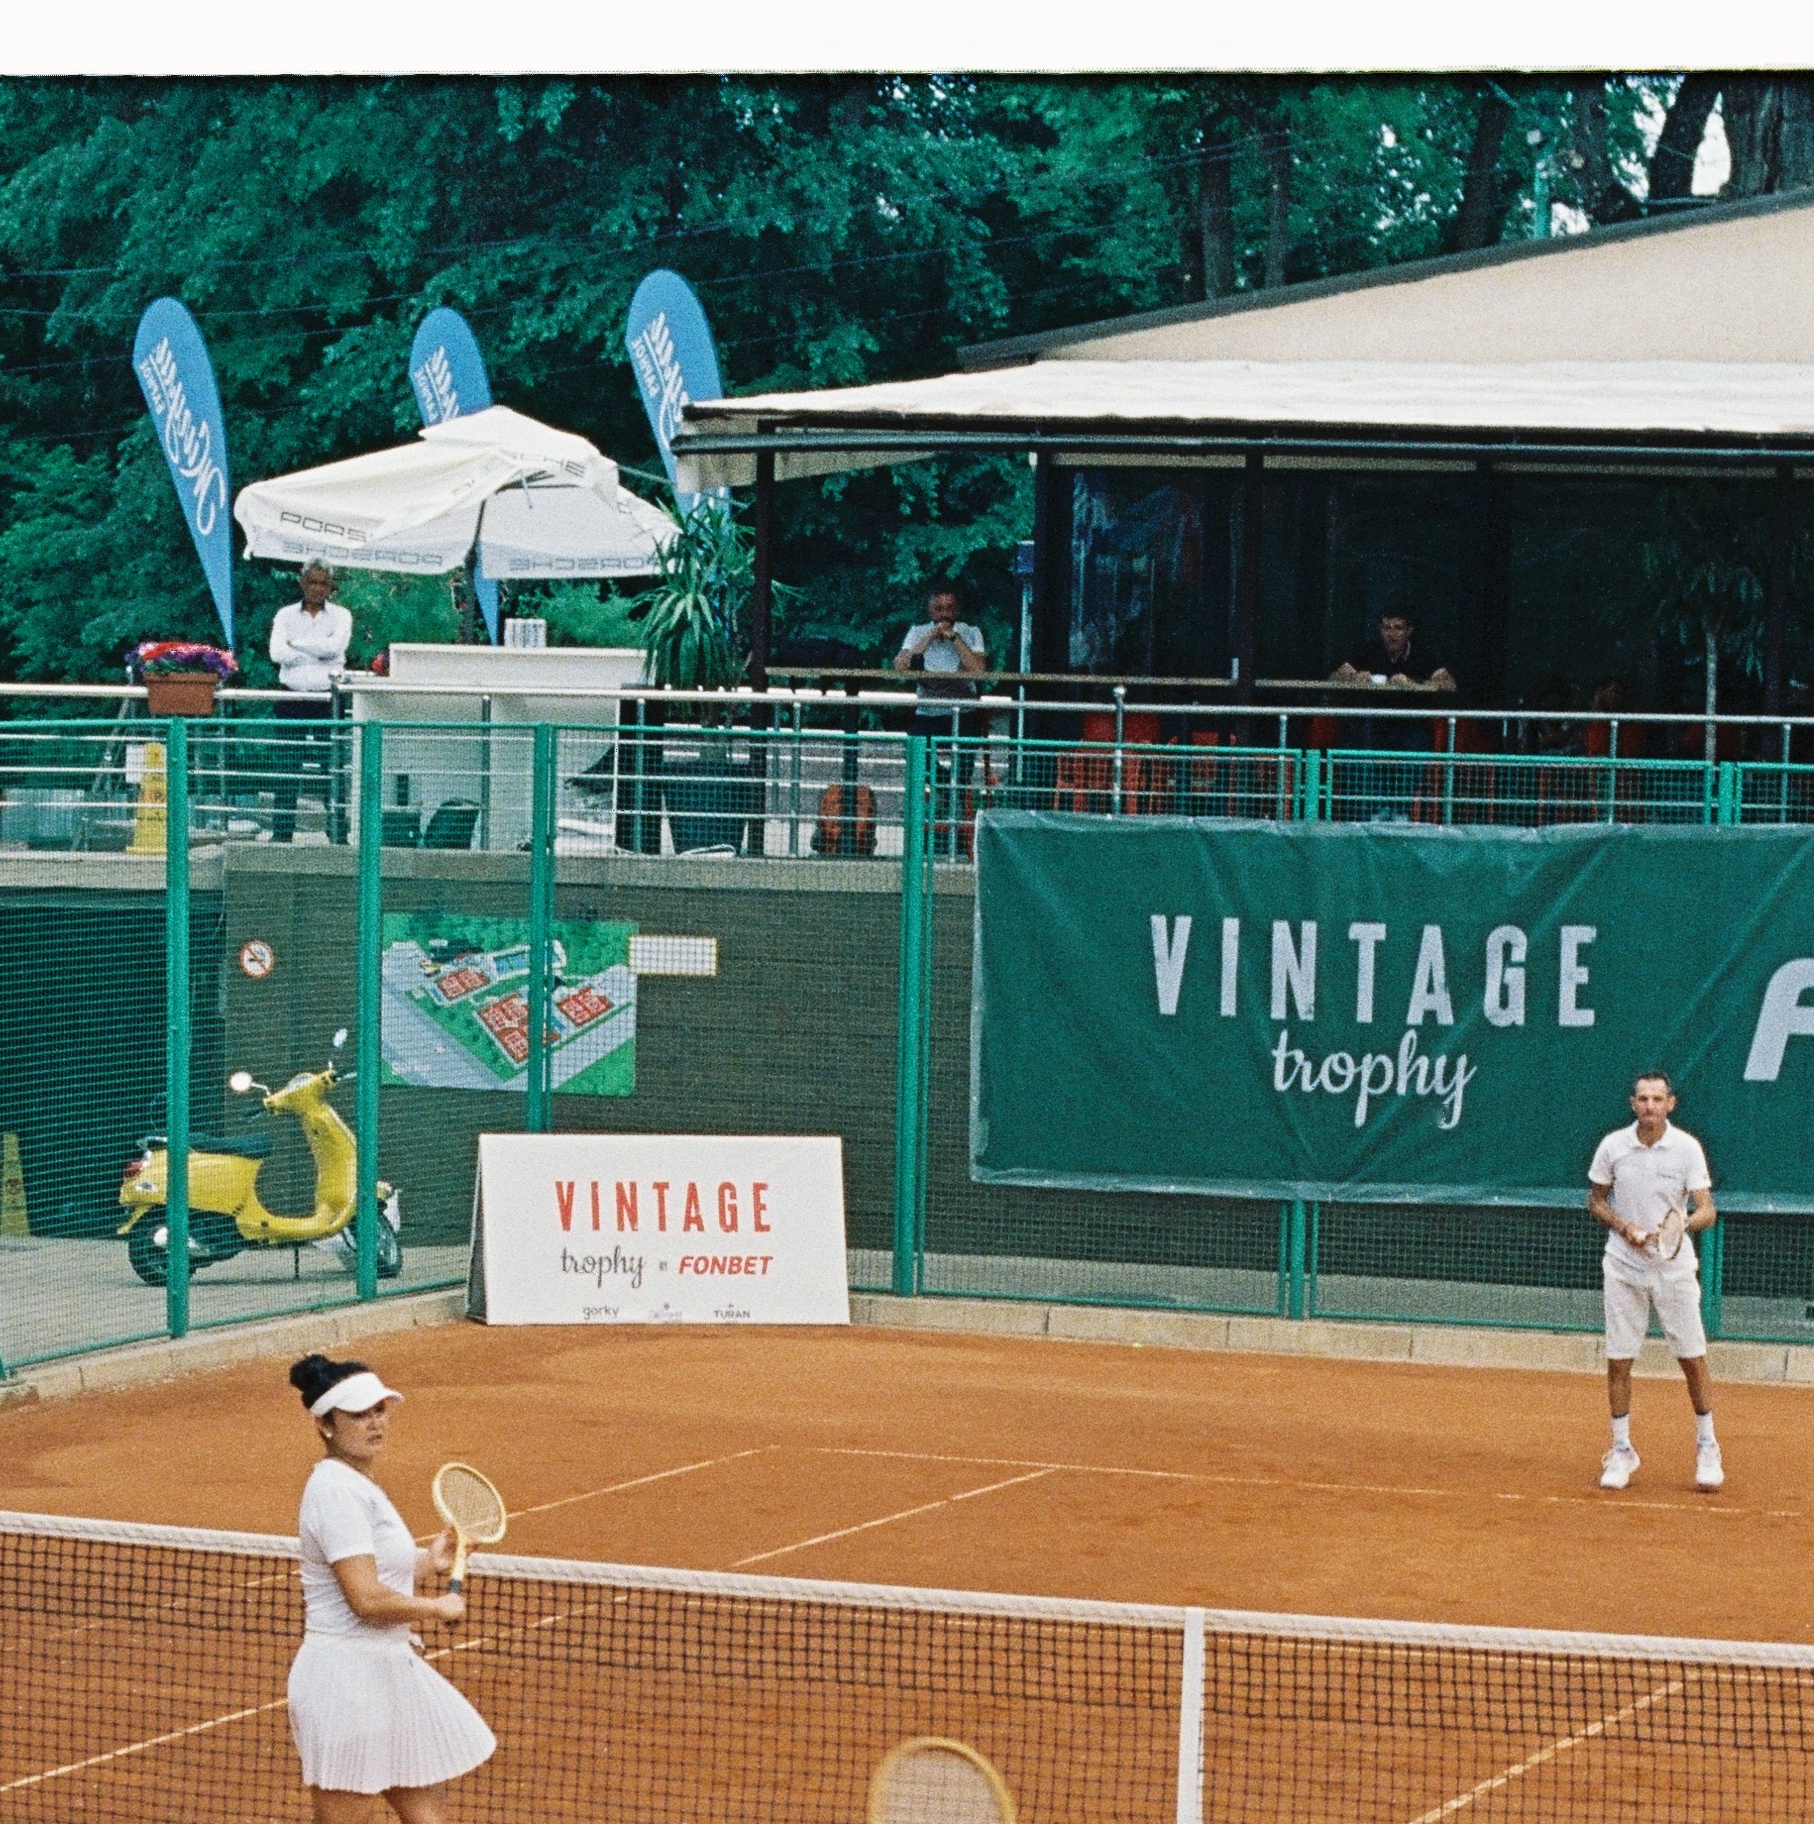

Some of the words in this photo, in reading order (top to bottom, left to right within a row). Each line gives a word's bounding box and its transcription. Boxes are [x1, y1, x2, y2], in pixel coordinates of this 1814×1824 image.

[280, 511, 367, 542] PORS
[1150, 914, 1597, 1028] VINTAGE
[1272, 1029, 1477, 1130] trophy
[555, 1181, 771, 1233] VINTAGE
[560, 1245, 647, 1289] trophy
[678, 1255, 773, 1276] FONBET
